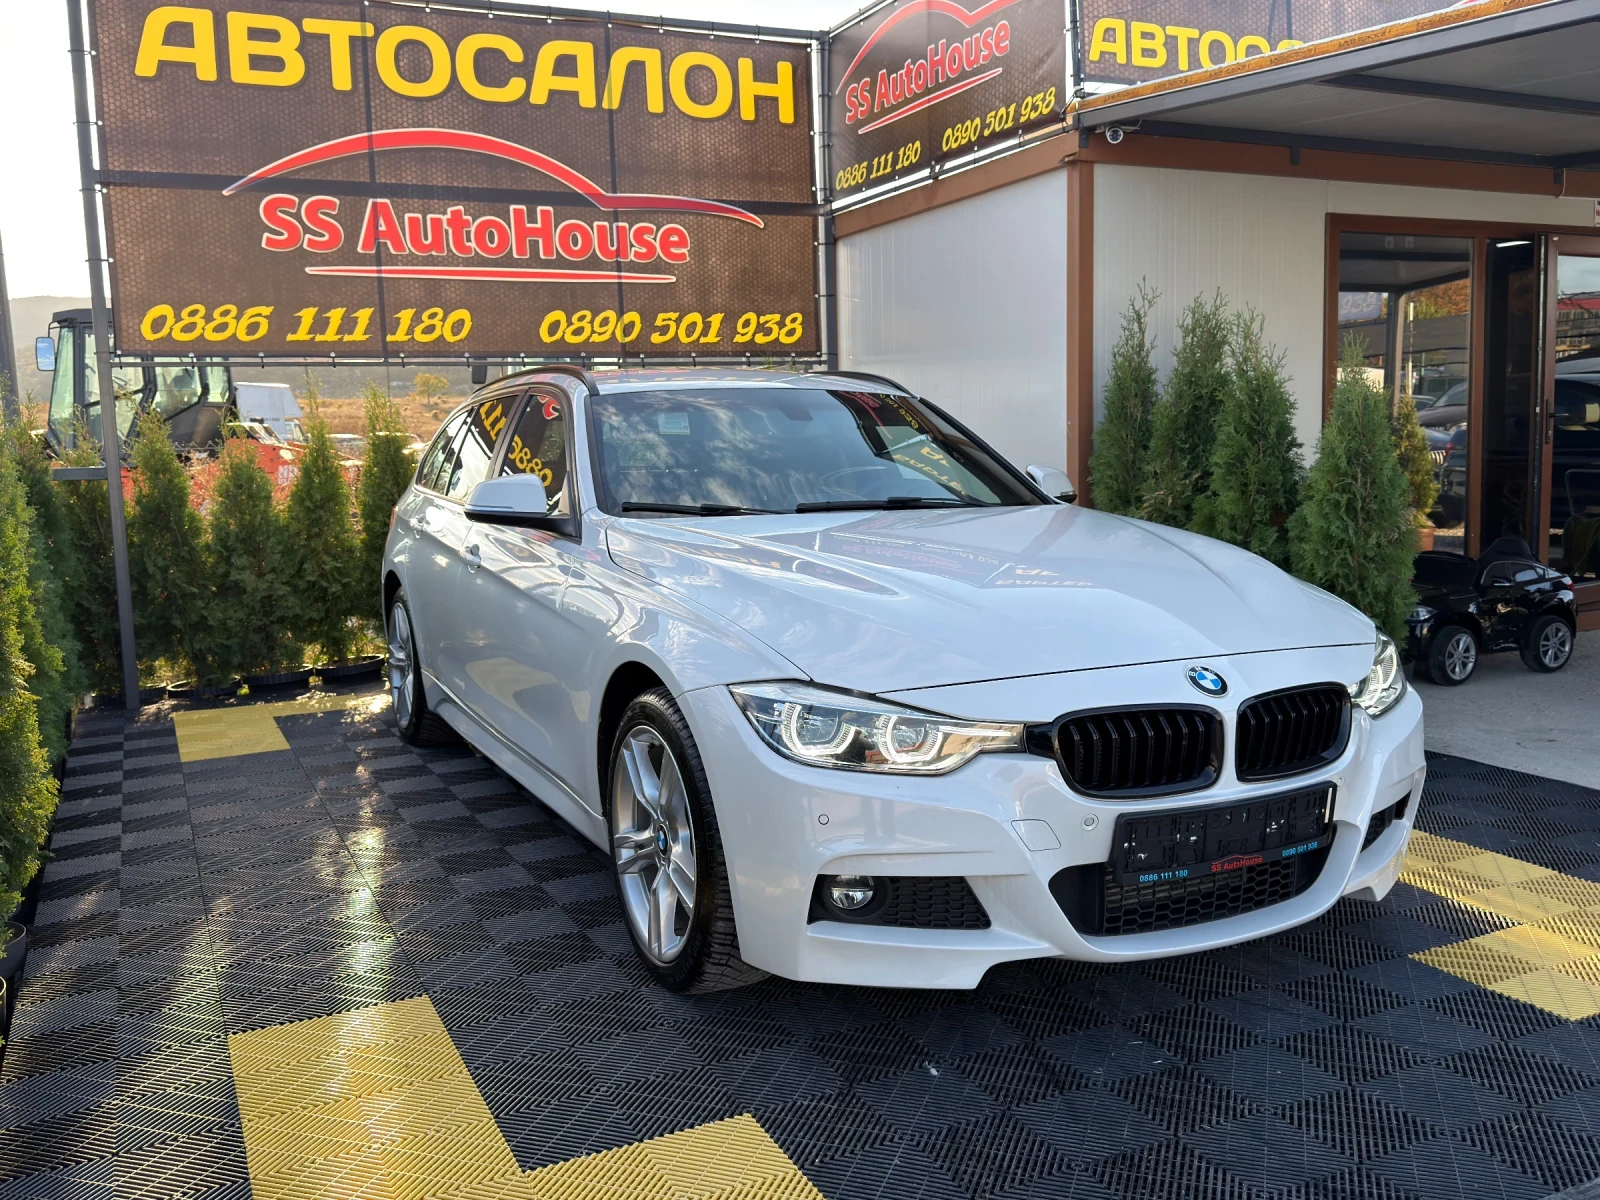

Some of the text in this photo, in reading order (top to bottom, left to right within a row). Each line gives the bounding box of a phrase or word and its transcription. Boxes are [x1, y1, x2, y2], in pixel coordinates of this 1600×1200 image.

[133, 5, 796, 125] АВТОСАЛОН
[844, 19, 1011, 125] SS AutoHouse
[942, 87, 1056, 152] 0890 501 938
[836, 140, 922, 191] 0886 111 180
[259, 193, 691, 266] SS AutoHouse
[140, 303, 473, 344] 0886 111 180
[539, 309, 803, 345] 0890 501 938
[1139, 869, 1189, 883] 0886 111 180
[1211, 863, 1222, 872] SS
